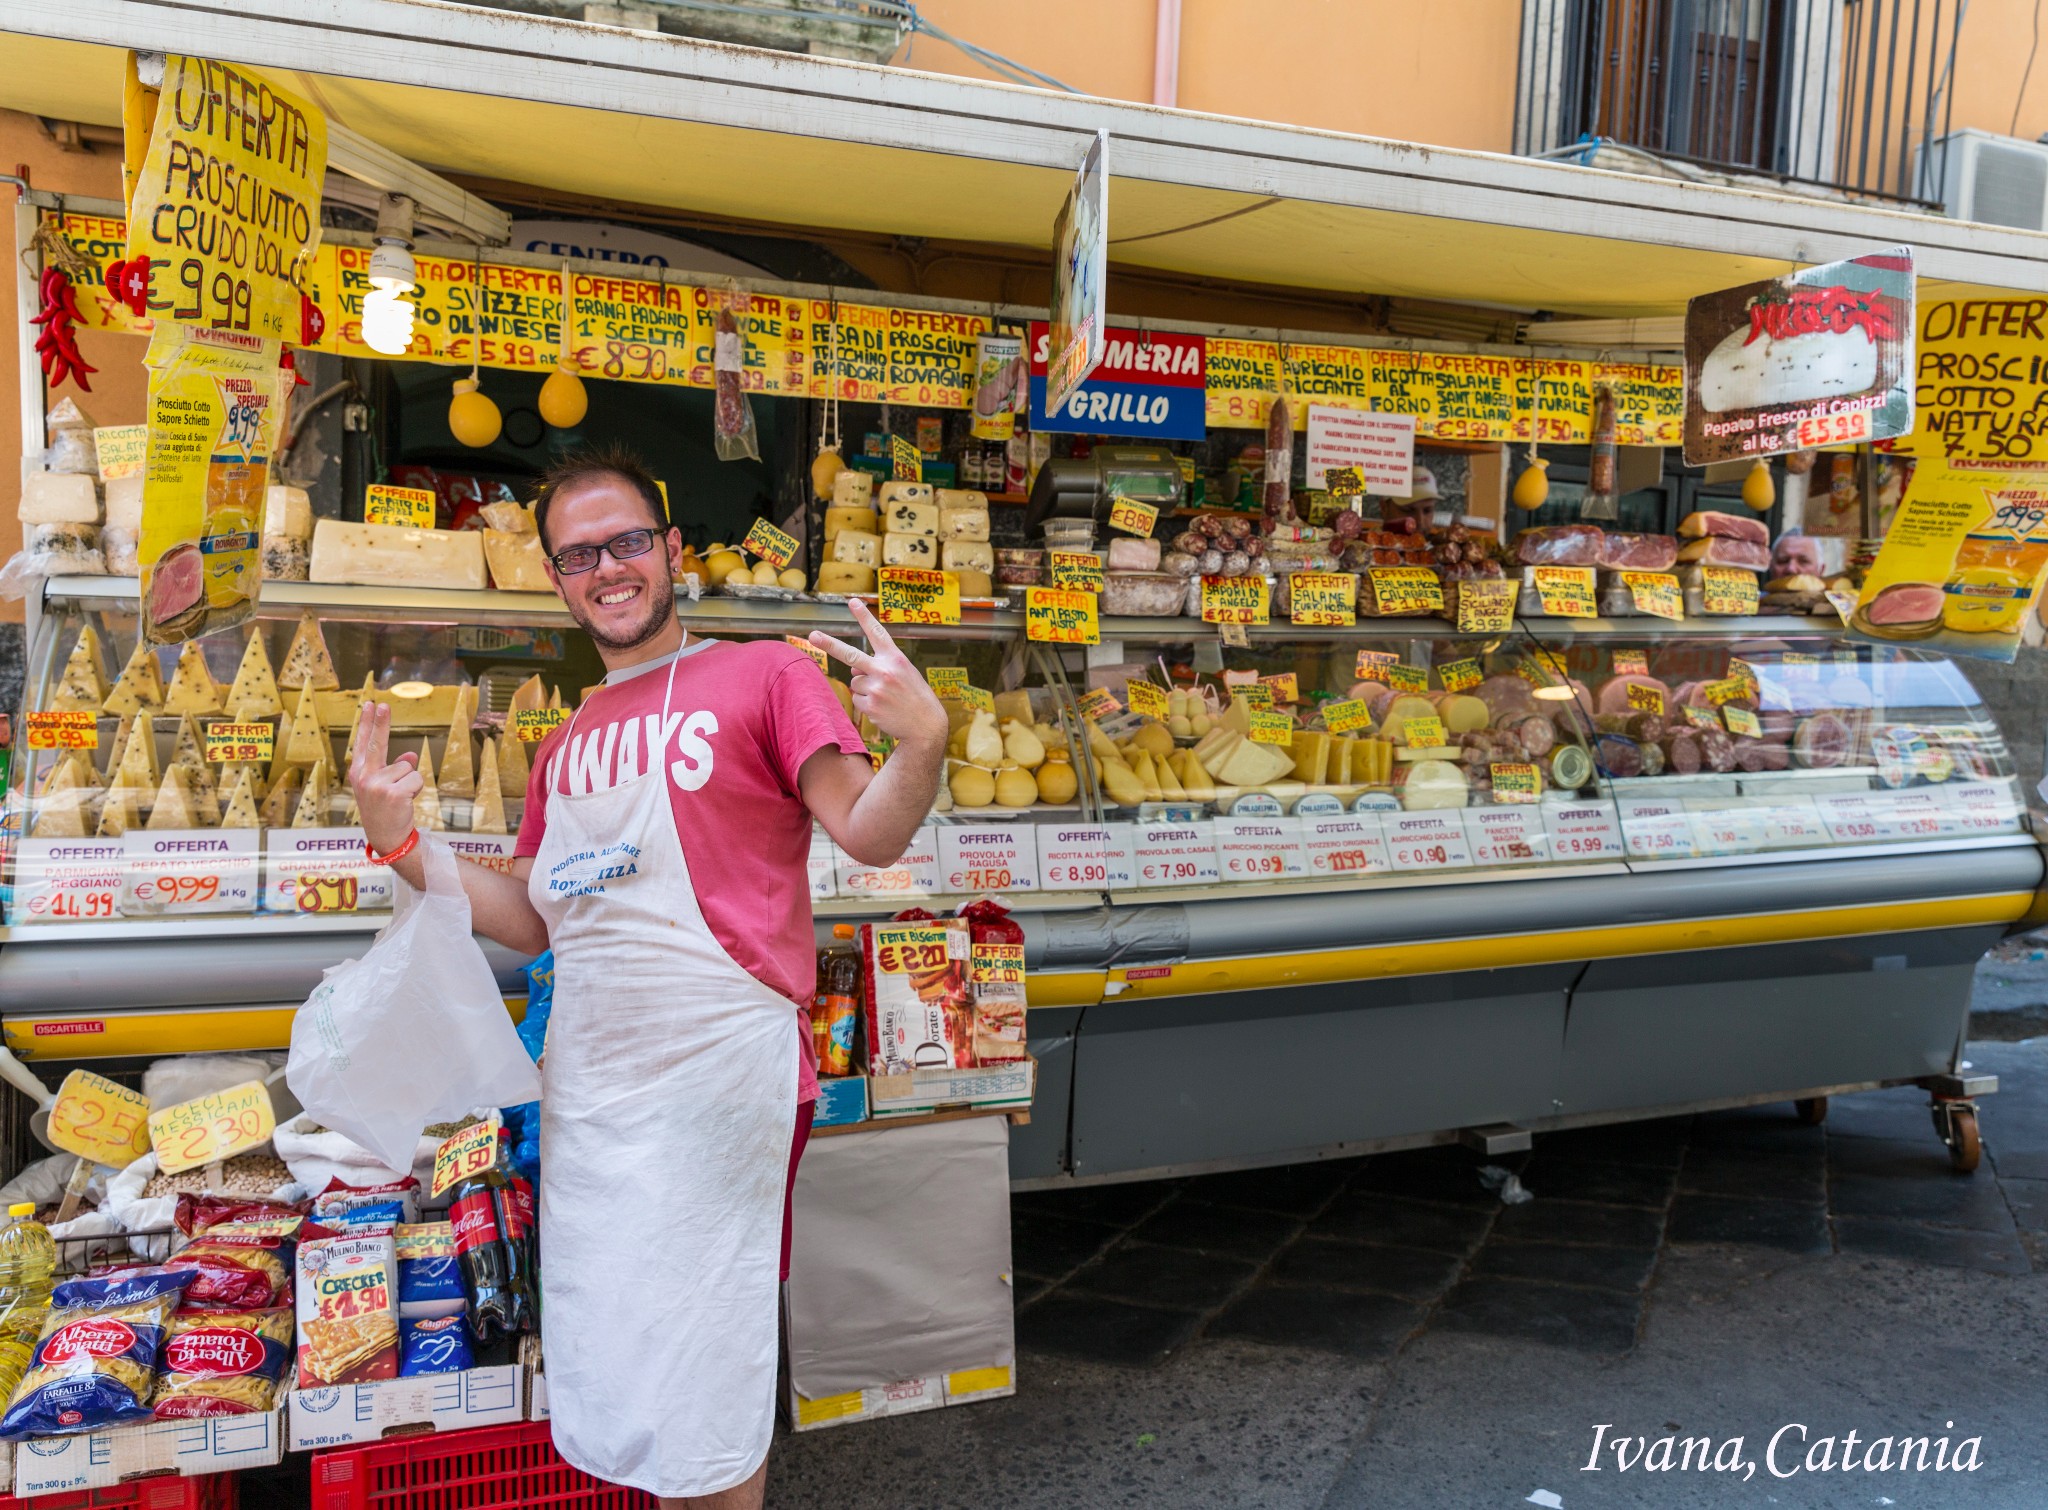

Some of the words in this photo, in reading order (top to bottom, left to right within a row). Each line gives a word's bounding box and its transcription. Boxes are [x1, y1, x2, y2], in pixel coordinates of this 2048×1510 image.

[174, 56, 309, 179] OFFERTA
[164, 140, 310, 244] PROSCIUTTO
[152, 203, 248, 269] CRUDO
[254, 233, 309, 290] DOLCE
[447, 263, 562, 295] OFFERTA
[575, 275, 682, 311] OFFERTA
[575, 298, 626, 320] GRANA
[631, 305, 688, 330] PADANO
[890, 310, 986, 337] OFFERTA
[605, 322, 686, 349] SCELTA
[1030, 333, 1201, 376] SMERIA
[1205, 339, 1278, 361] OFFERTA
[891, 350, 961, 370] COTTO
[1205, 356, 1276, 377] PROVOLE
[1433, 355, 1510, 378] OFFERTA
[225, 378, 252, 393] PREZZO
[1205, 374, 1280, 394] RAGUSANE
[1435, 373, 1501, 390] SALAME
[1389, 383, 1411, 397] AL
[1572, 382, 1590, 399] AL
[1917, 384, 2015, 409] COTTO
[157, 397, 192, 412] Prosciutto
[194, 400, 211, 413] Cotto
[236, 394, 269, 409] SPECIALE
[1067, 390, 1170, 425] GRILLO
[1370, 396, 1431, 414] FORNO
[156, 412, 182, 427] Sapore
[184, 414, 210, 426] Schietto
[1703, 416, 1754, 440] Pepato
[1758, 407, 1808, 428] Fresco
[1811, 402, 1827, 419] di
[1829, 391, 1888, 414] Capizzi
[169, 432, 187, 441] Coscia
[1742, 435, 1757, 452] al
[1760, 431, 1783, 451] kg.
[1943, 430, 2033, 459] 7.50
[157, 464, 177, 473] Glutine
[156, 474, 184, 483] Polifosfati
[1997, 490, 2038, 501] PREZZO
[1052, 554, 1099, 567] OFFERTA
[880, 568, 945, 585] OFFERTA
[1371, 568, 1432, 579] OFFERTA
[1204, 575, 1262, 589] OFFERTA
[1292, 574, 1351, 589] OFFERTA
[1205, 585, 1246, 598] SAPORI
[1293, 589, 1345, 602] SALAME
[1033, 590, 1090, 611] OFFERTA
[1220, 597, 1259, 608] ANGELO
[28, 711, 89, 723] OFFERTA
[210, 723, 270, 736] OFFERTA
[1237, 804, 1278, 813] PHILADELPHIA
[1300, 804, 1340, 813] PHILADELPHIA
[1359, 802, 1397, 811] PHILADELPHIA
[1479, 813, 1524, 824] OFFERTA
[1558, 809, 1603, 821] OFFERTA
[1234, 826, 1283, 836] OFFERTA
[1316, 822, 1364, 834] OFFERTA
[1400, 818, 1446, 830] OFFERTA
[1484, 826, 1525, 835] PANCETTA
[959, 833, 1014, 845] OFFERTA
[1057, 831, 1112, 843] OFFERTA
[1147, 830, 1198, 842] OFFERTA
[1391, 834, 1434, 844] AURICCHIO
[1435, 831, 1462, 840] DOLCE
[154, 840, 229, 853] OFFERTA
[296, 838, 367, 852] OFFERTA
[1135, 848, 1170, 857] PROVOLA
[1172, 847, 1186, 856] DEL
[1188, 845, 1217, 854] CASALE
[1222, 843, 1263, 851] AURICCHIO
[1263, 843, 1300, 851] PICCANTE
[1571, 837, 1602, 854] 9,99
[959, 850, 1005, 860] PROVOLA
[1007, 850, 1016, 859] DI
[1047, 851, 1079, 860] RICOTTA
[1082, 851, 1094, 860] AL
[1096, 850, 1125, 859] FORNO
[1414, 845, 1447, 864] 0,90
[131, 858, 188, 870] PEPATO
[191, 857, 251, 869] VECCHIO
[279, 860, 327, 872] GRANA
[550, 850, 596, 876] INDUSTRIA
[968, 858, 1009, 868] RAGUSA
[1246, 855, 1283, 875] 0,99
[1068, 865, 1106, 884] 8,90
[1117, 871, 1129, 882] Kg
[1160, 862, 1196, 880] 7,90
[1207, 868, 1219, 878] Kg
[50, 878, 122, 889] REGGIANO
[1020, 877, 1031, 887] Kg
[219, 889, 229, 898] al
[232, 887, 246, 899] Kg
[359, 884, 369, 894] al
[371, 884, 385, 895] Kg
[564, 885, 605, 899] CATANIA
[975, 945, 1023, 958] OFFERTA
[973, 957, 992, 969] PAN
[36, 1022, 101, 1035] OSCARTIELLE
[172, 1093, 223, 1120] CECI
[438, 1122, 489, 1158] OFFERTA
[464, 1135, 494, 1152] COLA
[345, 1200, 372, 1211] MULINO
[326, 1245, 355, 1260] MULINO
[355, 1241, 382, 1254] BIANCO
[321, 1271, 386, 1296] CRECKER
[53, 1326, 125, 1344] Alberto
[53, 1337, 114, 1358] Poiatti
[184, 1334, 249, 1352] Poiatti
[178, 1349, 253, 1369] Alberto
[43, 1385, 84, 1400] FARFALLE
[84, 1381, 97, 1392] 82
[299, 1438, 315, 1447] Tara
[315, 1436, 329, 1446] 300
[341, 1433, 353, 1442] 8%
[26, 1481, 44, 1491] Tara
[44, 1480, 59, 1490] 300
